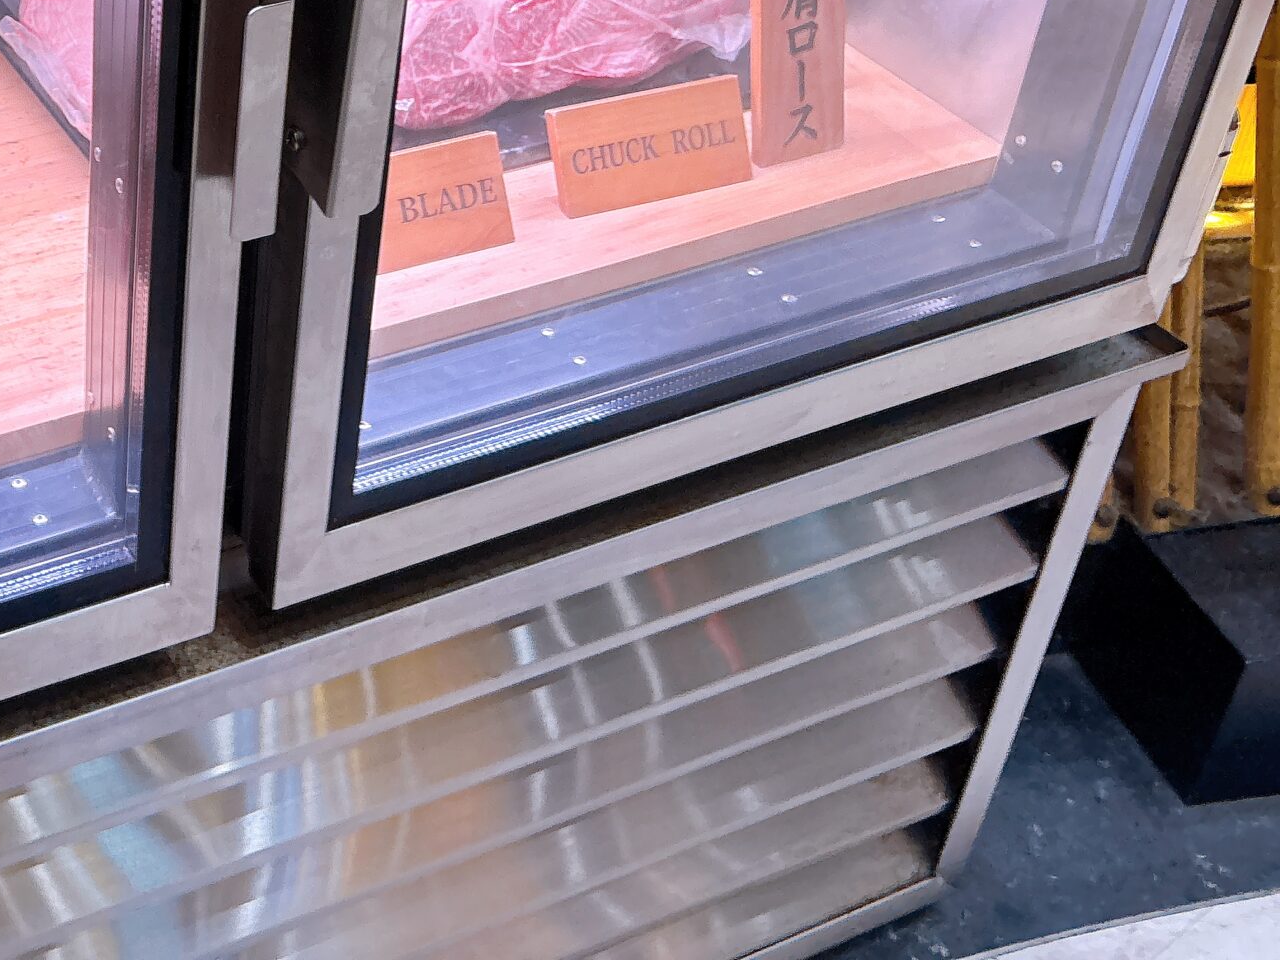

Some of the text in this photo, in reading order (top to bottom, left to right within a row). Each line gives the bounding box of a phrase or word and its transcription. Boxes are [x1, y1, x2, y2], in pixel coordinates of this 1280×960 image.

[571, 119, 736, 176] CHUCK ROLL
[396, 177, 499, 225] BLADE
